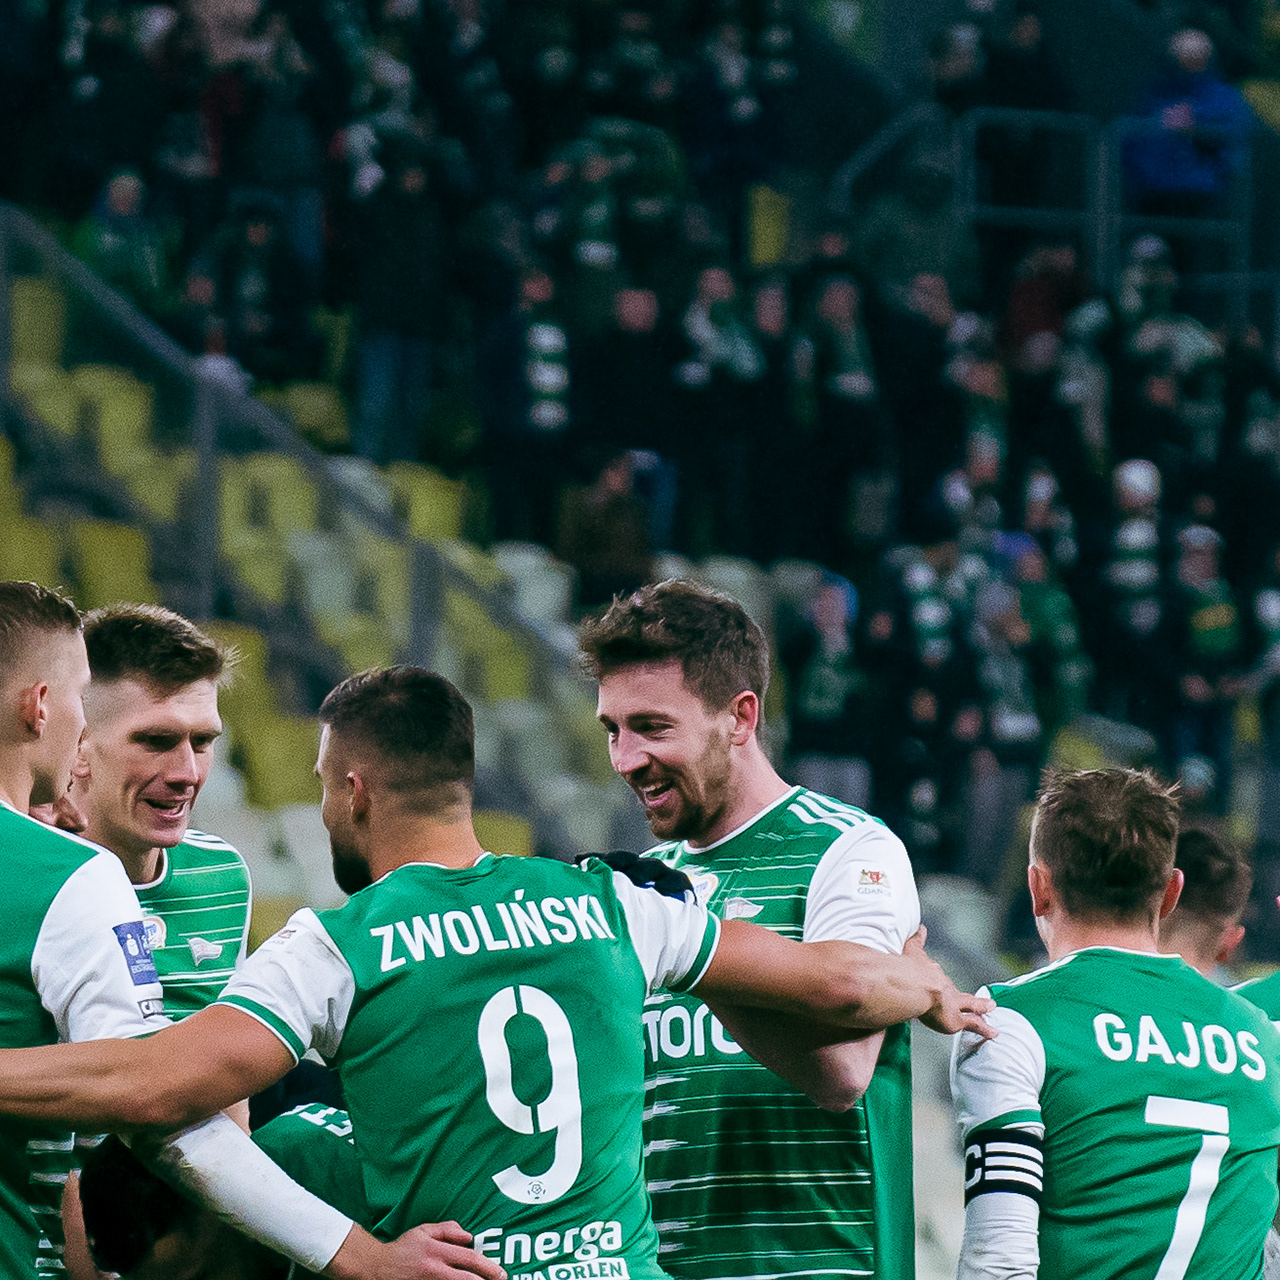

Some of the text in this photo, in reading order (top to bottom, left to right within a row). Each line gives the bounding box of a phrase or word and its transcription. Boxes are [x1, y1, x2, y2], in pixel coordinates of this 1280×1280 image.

[371, 889, 617, 973] ZWOLIŃSKI
[1093, 1012, 1267, 1082] GAJOS
[477, 985, 582, 1204] 9
[473, 1221, 623, 1266] Energa
[554, 1261, 625, 1280] ORLEN
